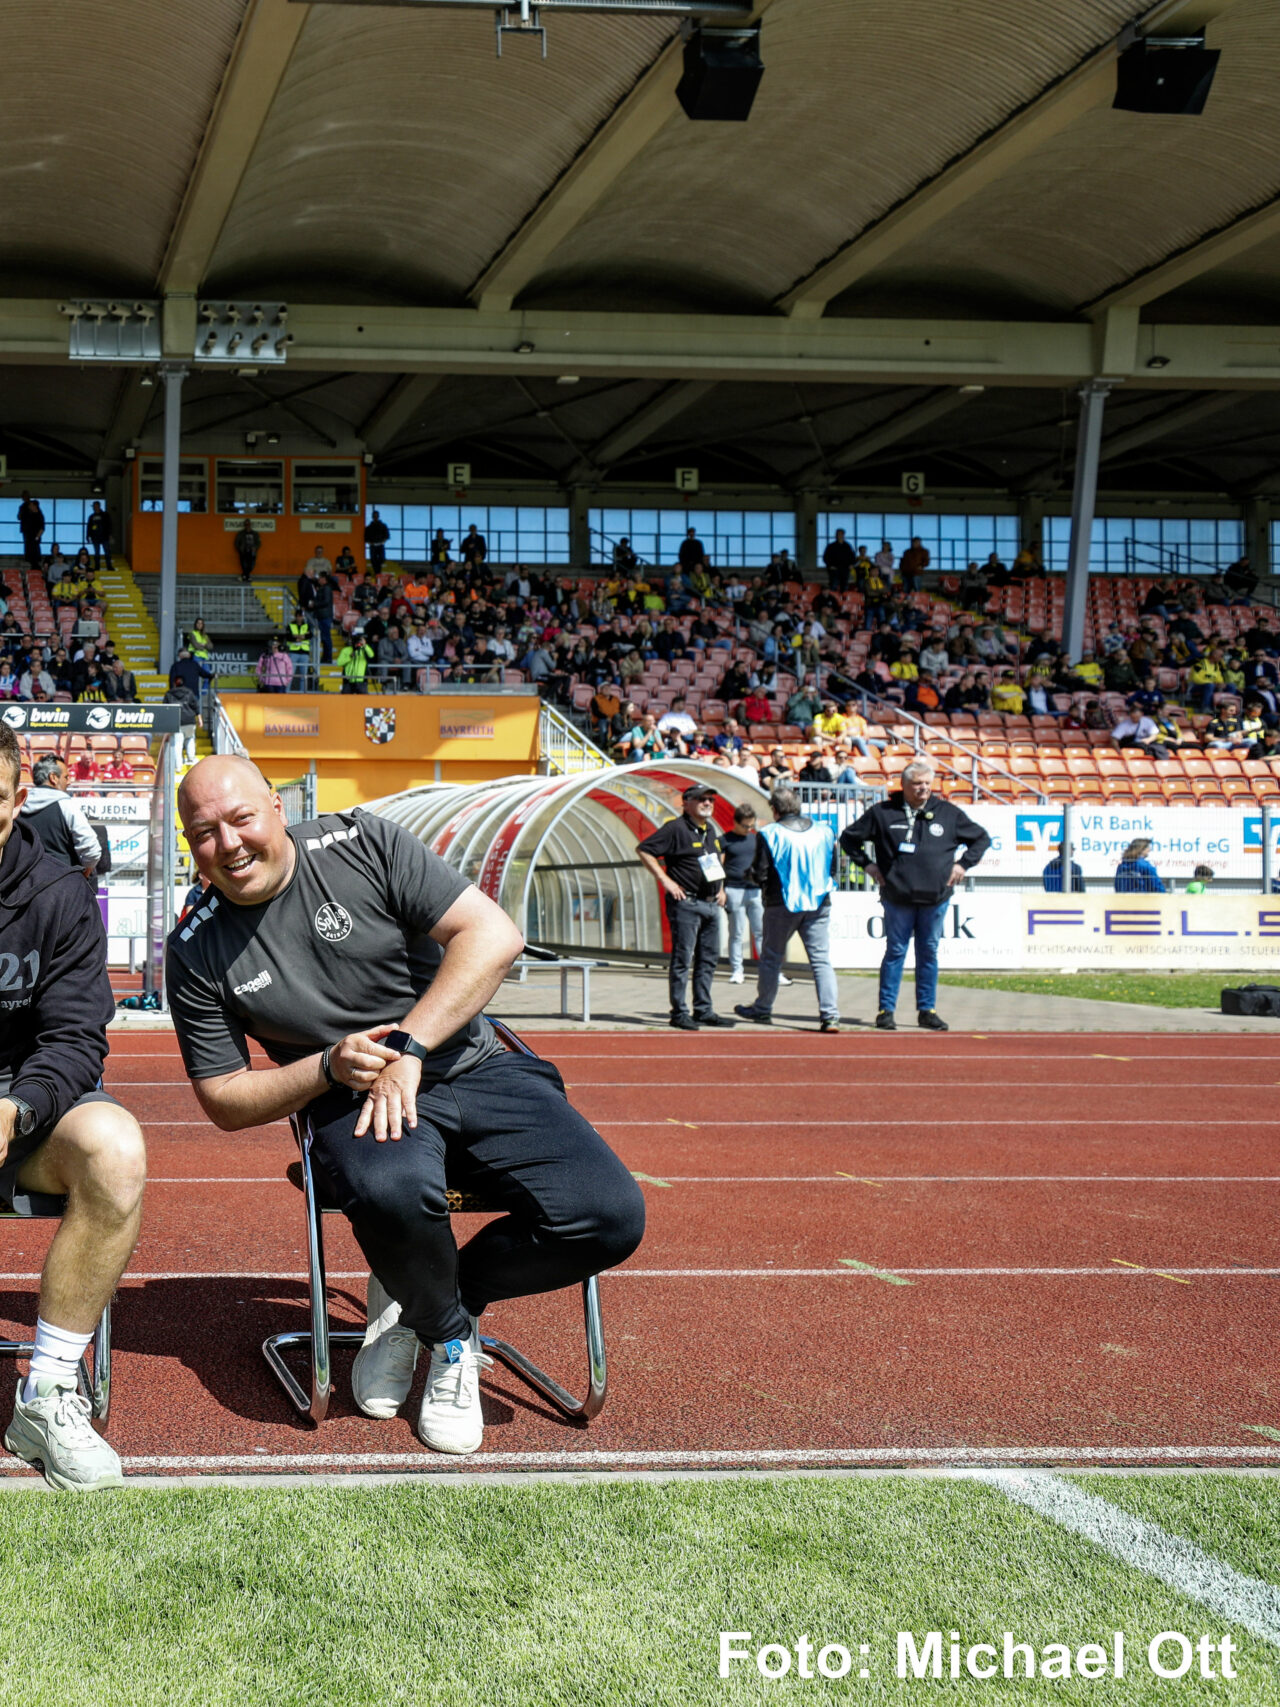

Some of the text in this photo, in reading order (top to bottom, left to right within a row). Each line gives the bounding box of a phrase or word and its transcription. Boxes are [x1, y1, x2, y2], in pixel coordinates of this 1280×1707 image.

[453, 466, 465, 483] E
[681, 470, 693, 488] F
[906, 475, 919, 492] G
[207, 652, 248, 661] NWELLE
[208, 664, 248, 674] UNGE
[30, 707, 70, 723] bwin
[115, 708, 154, 724] bwin
[265, 724, 319, 733] BAYREUTH
[440, 725, 494, 735] BAYREUTH
[101, 805, 137, 814] JEDEN
[1080, 816, 1154, 830] VR Bank
[1081, 836, 1230, 856] Bayreh-Hof eG
[483, 839, 504, 894] kasse
[492, 850, 509, 899] euth
[233, 969, 272, 995] capelli
